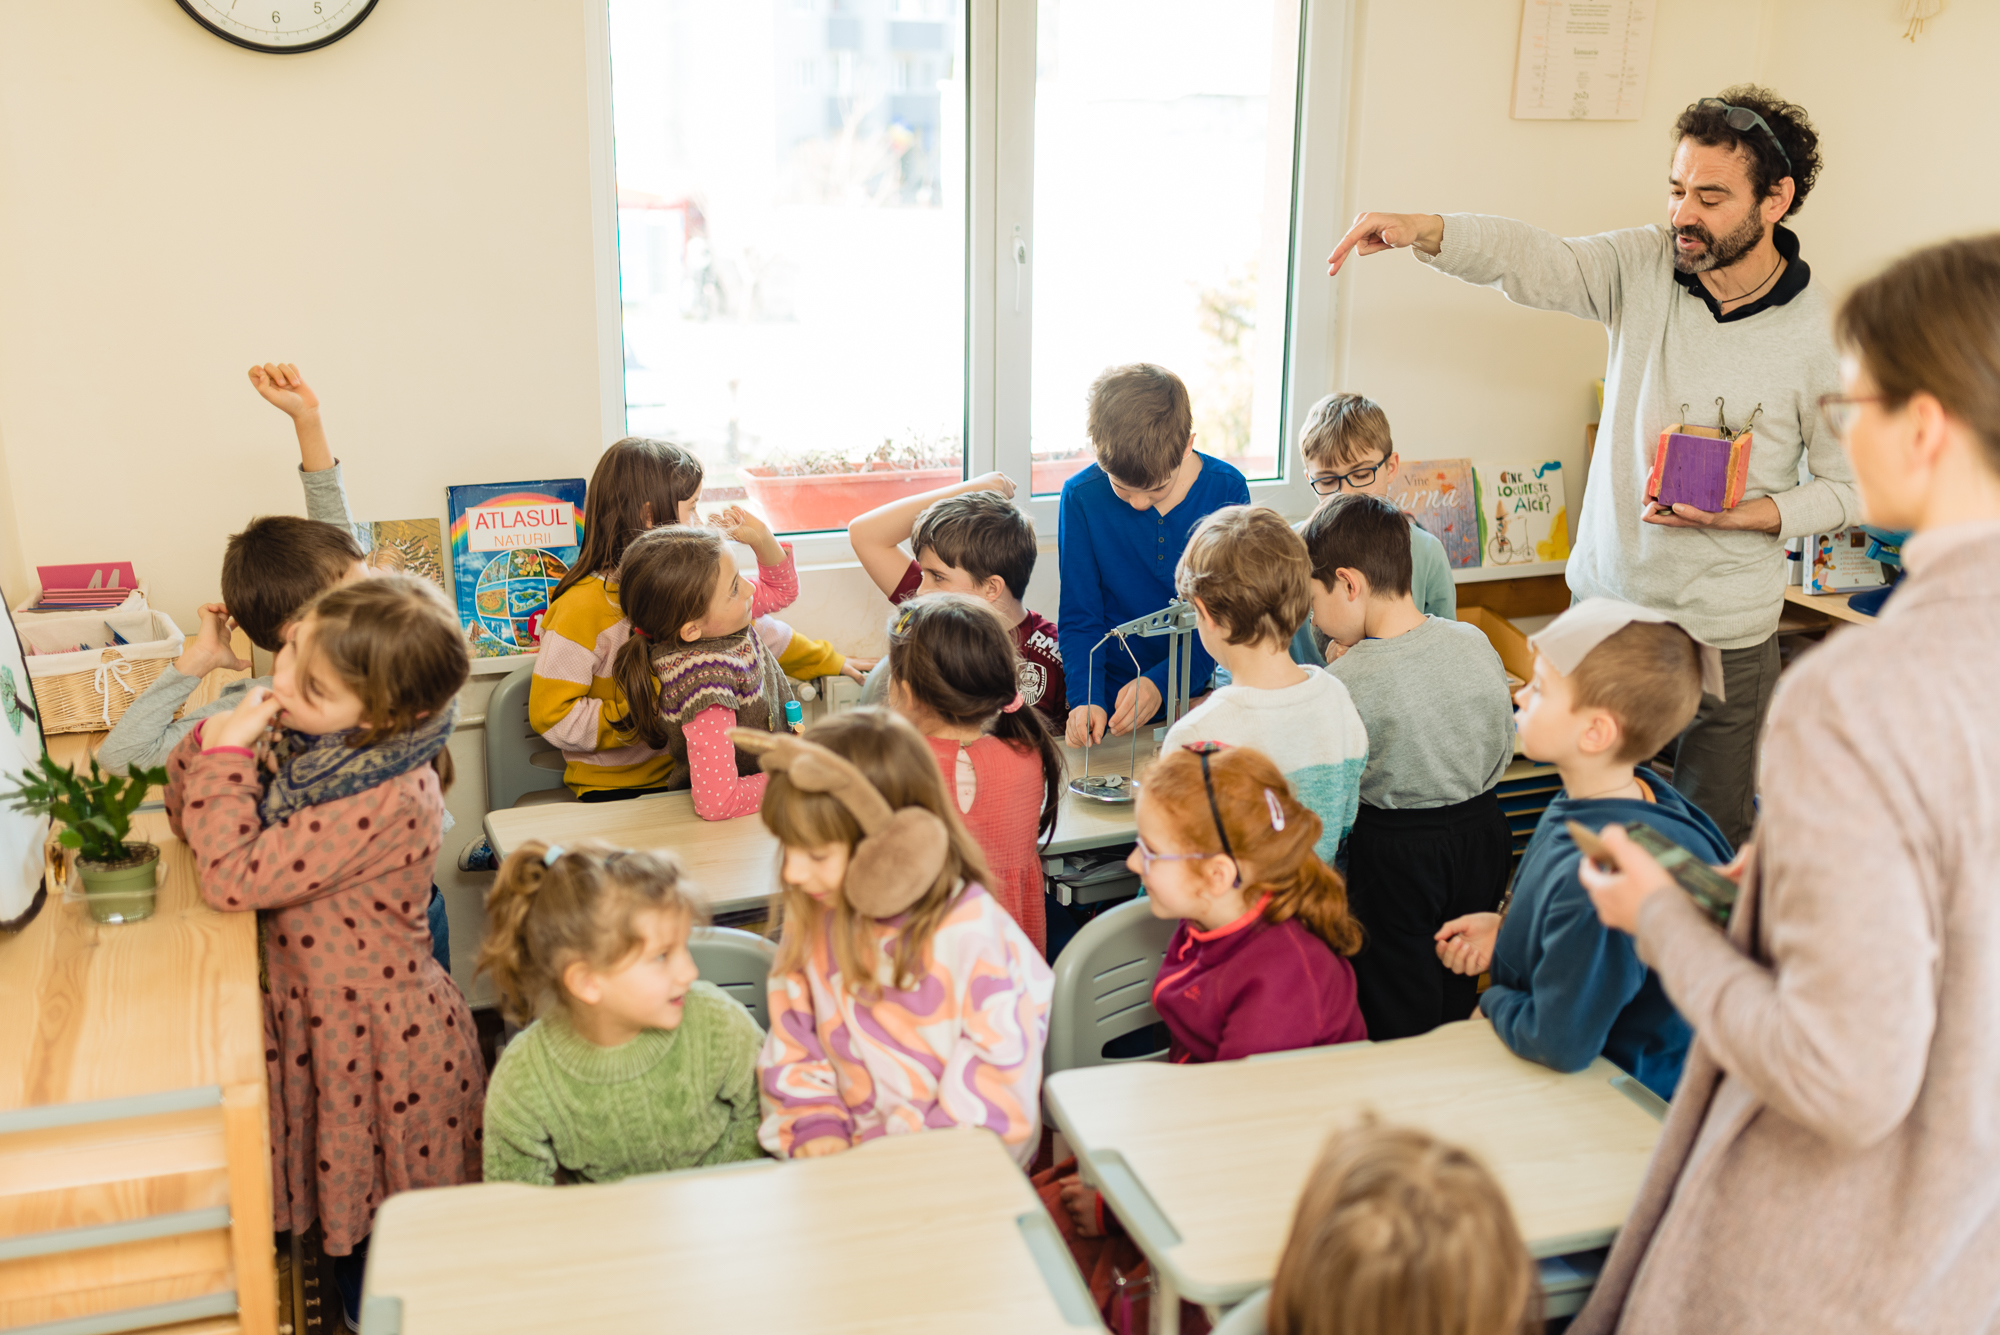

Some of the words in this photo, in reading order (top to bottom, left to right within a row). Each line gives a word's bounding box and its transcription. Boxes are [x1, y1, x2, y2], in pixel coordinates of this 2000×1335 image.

[313, 1, 323, 15] 5
[271, 10, 281, 24] 6
[1404, 474, 1429, 487] Vine
[475, 508, 567, 530] ATLASUL
[494, 532, 551, 547] NATURII
